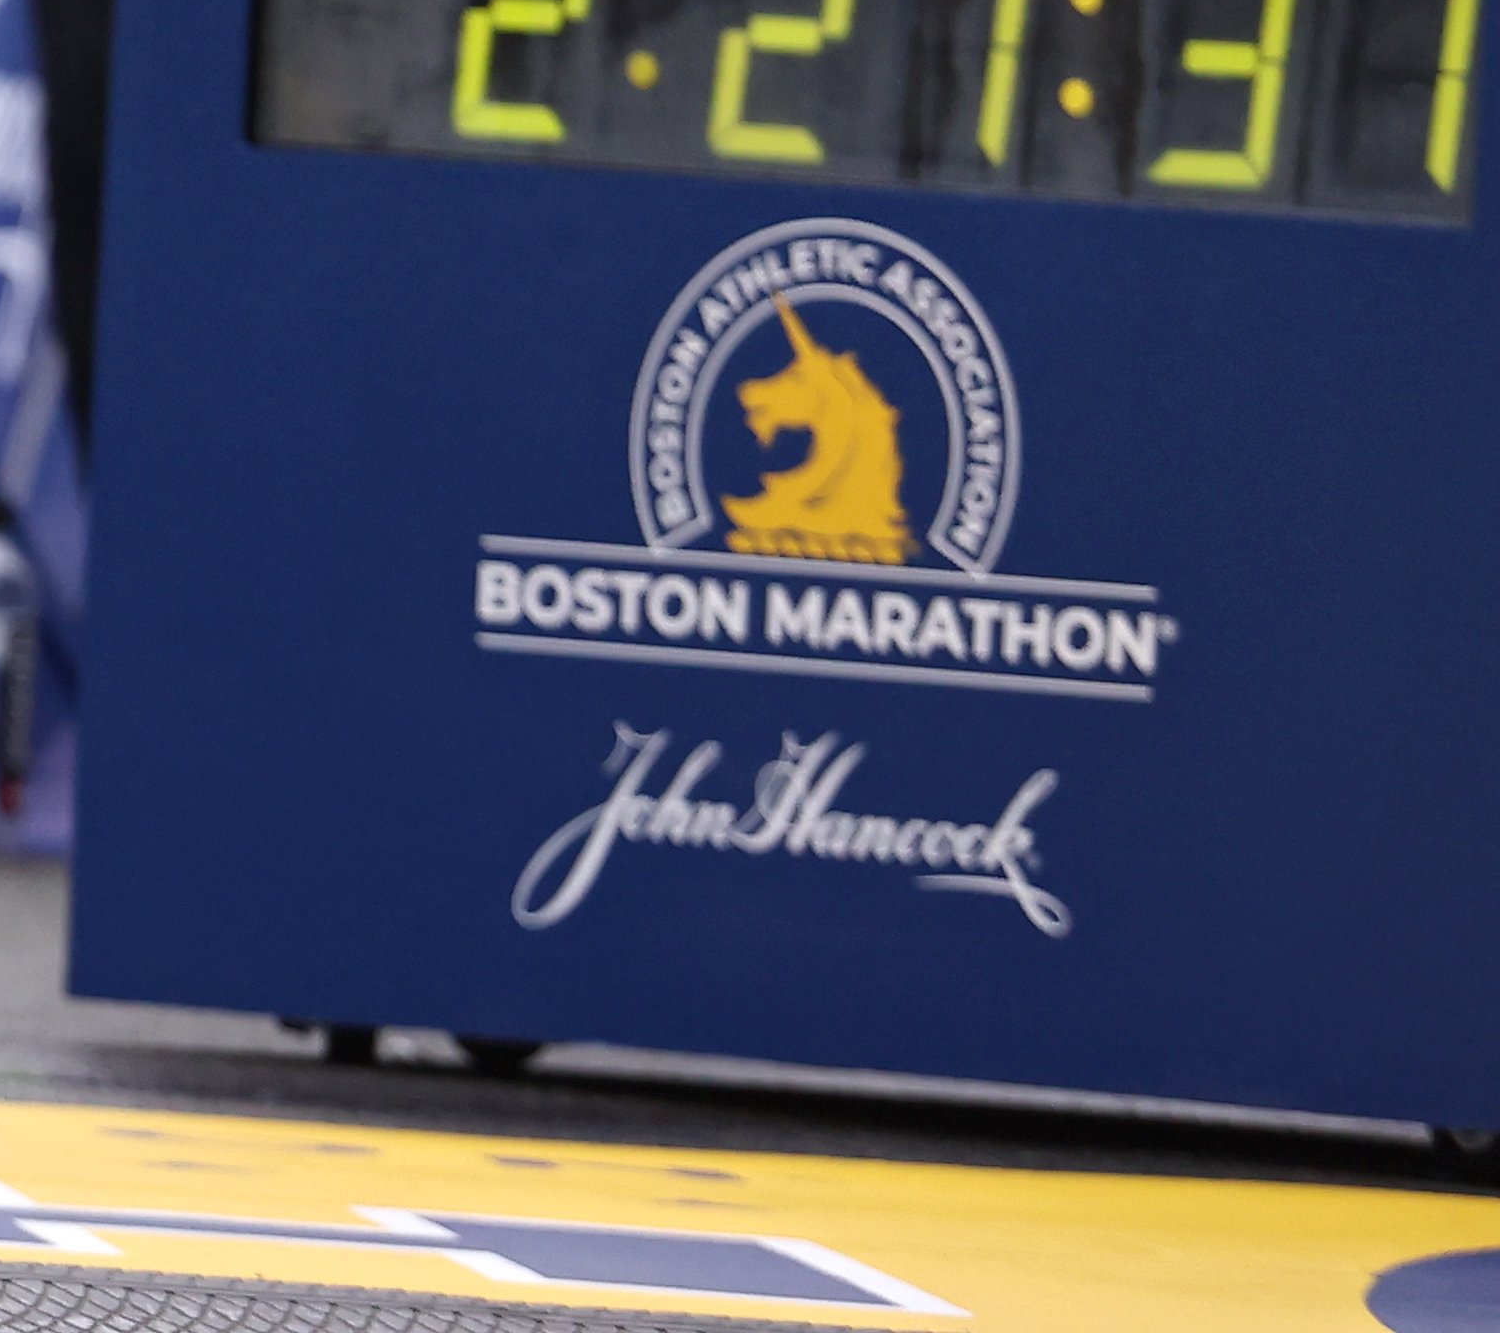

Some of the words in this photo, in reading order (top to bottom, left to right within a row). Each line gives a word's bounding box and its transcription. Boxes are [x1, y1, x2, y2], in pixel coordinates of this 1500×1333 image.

[698, 238, 882, 340] ATHLETIC
[878, 259, 1002, 555] ASSOCIATION
[475, 559, 752, 645] BOSTON
[510, 718, 738, 931] John
